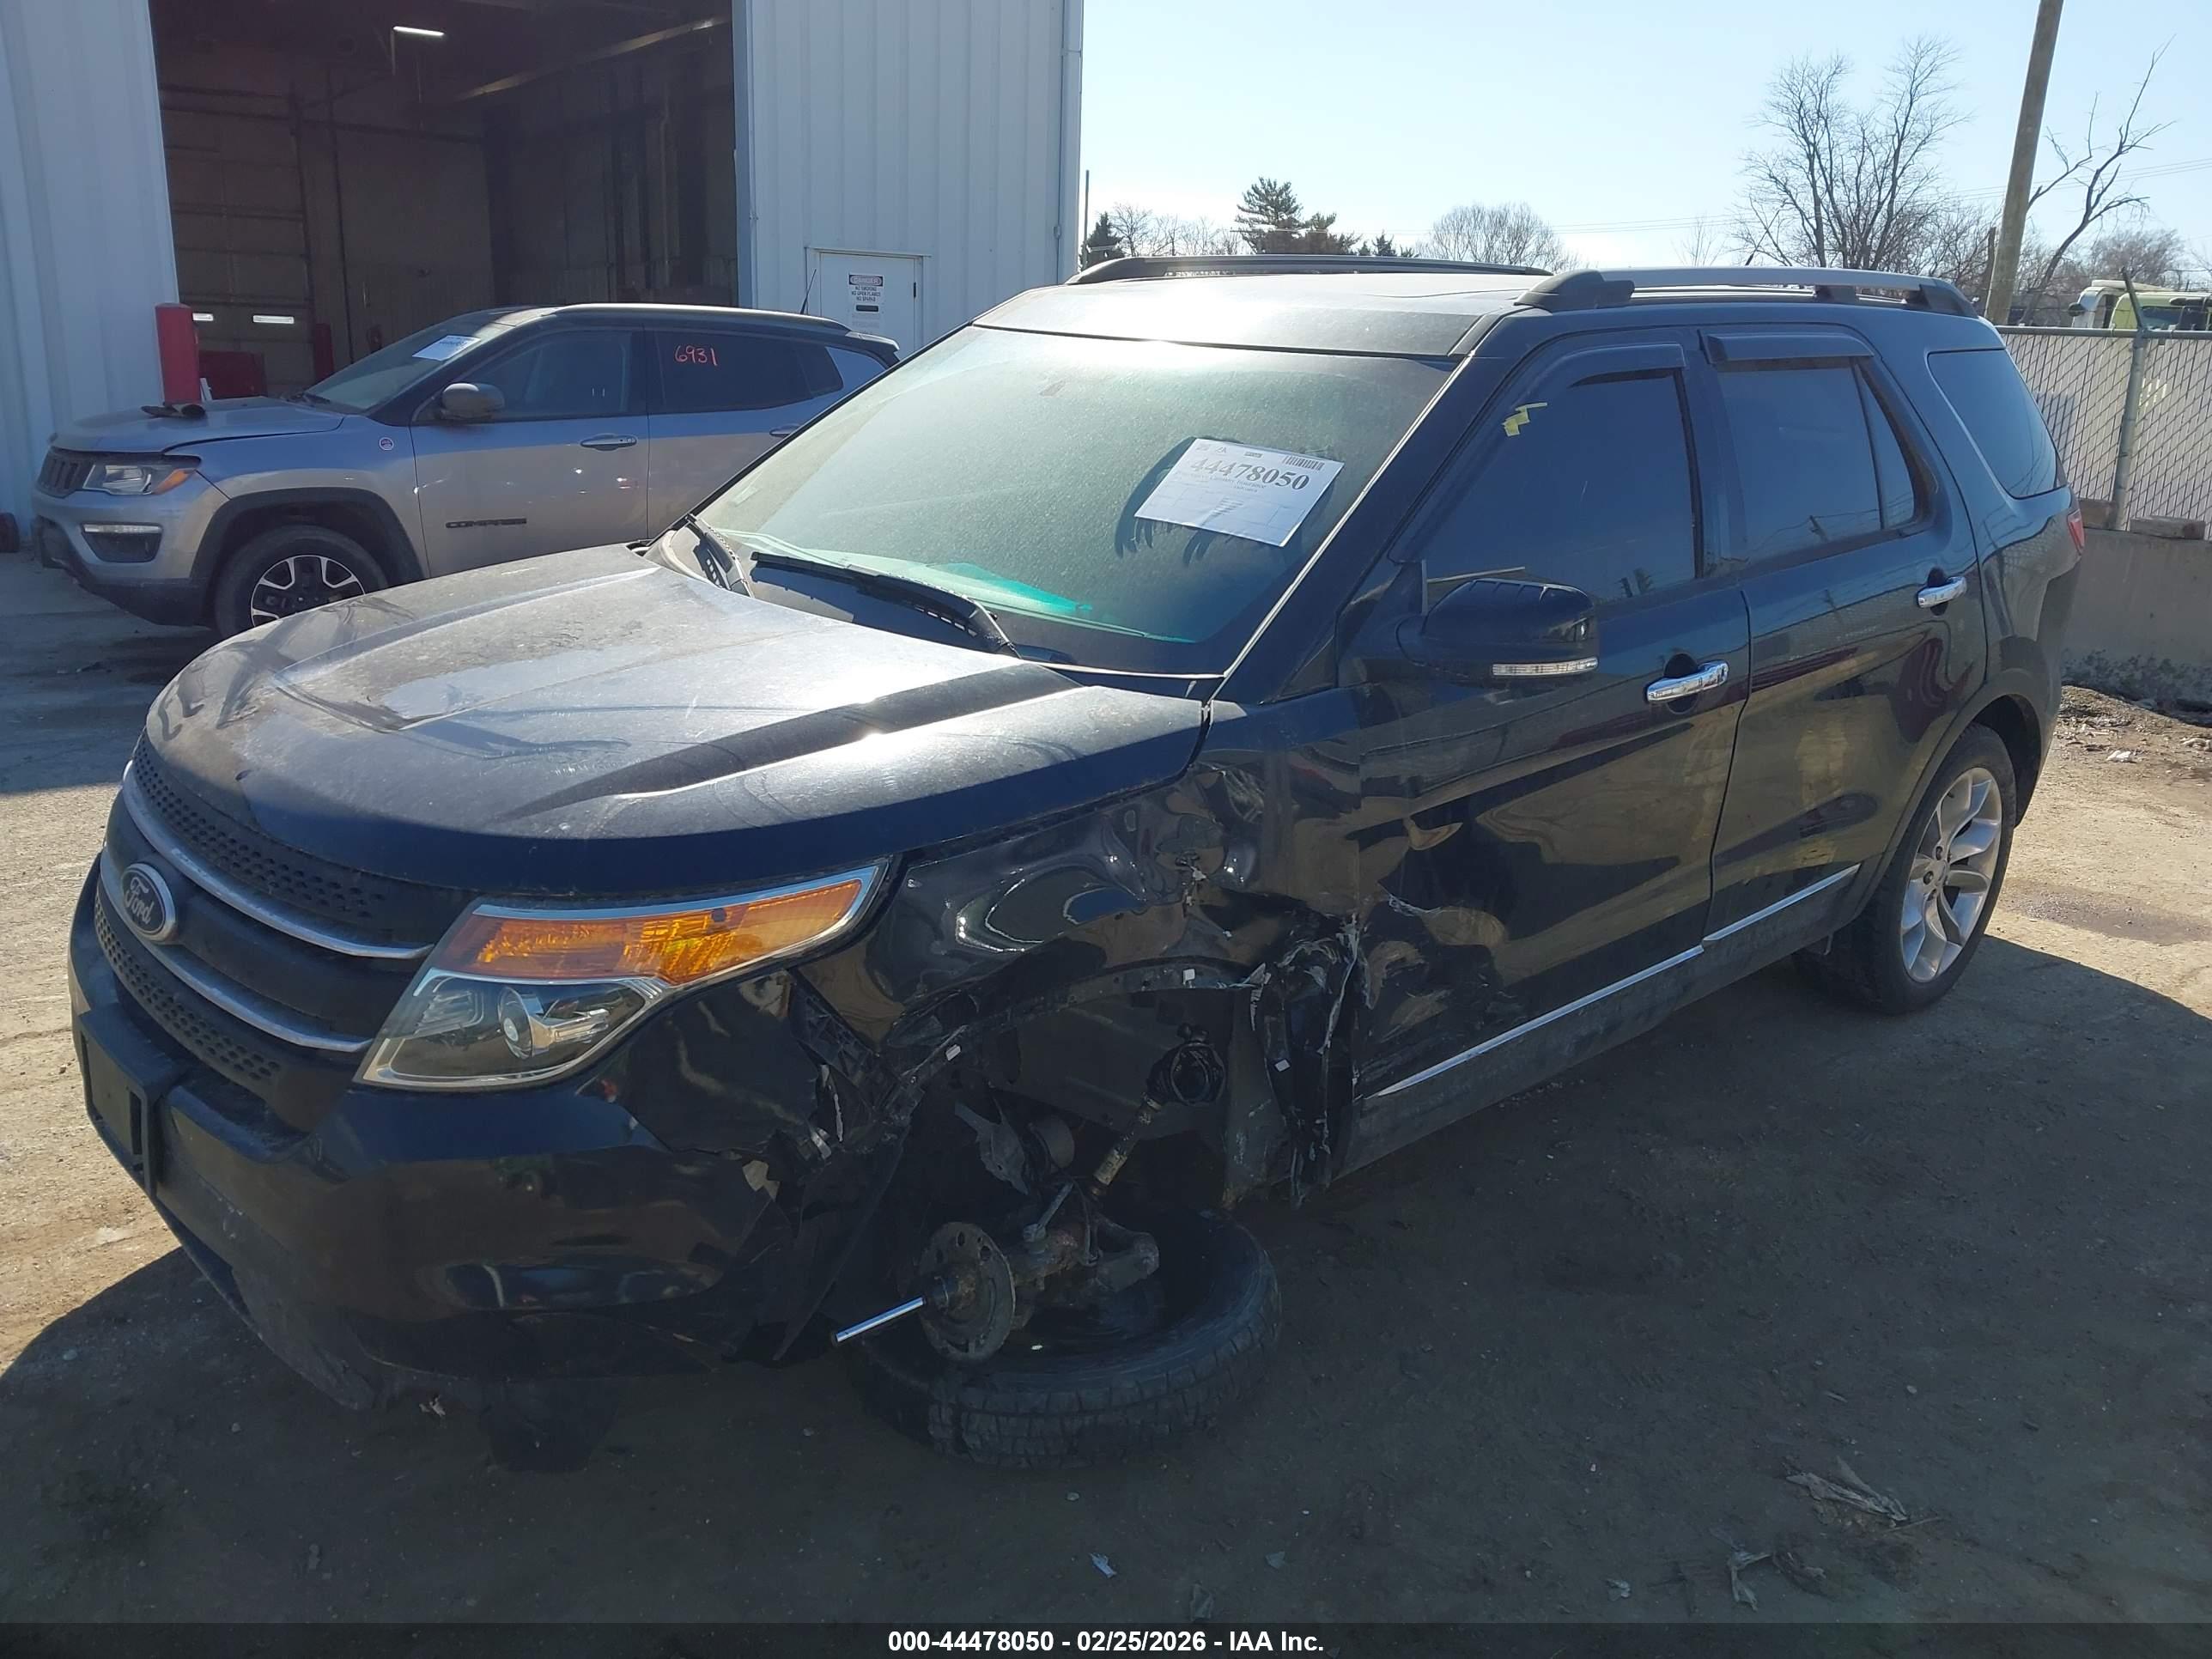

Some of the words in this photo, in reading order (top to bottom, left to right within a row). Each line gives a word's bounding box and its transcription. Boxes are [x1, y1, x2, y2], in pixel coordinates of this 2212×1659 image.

[675, 345, 718, 367] 6931
[1189, 457, 1310, 490] 44478050
[125, 876, 155, 925] Ford
